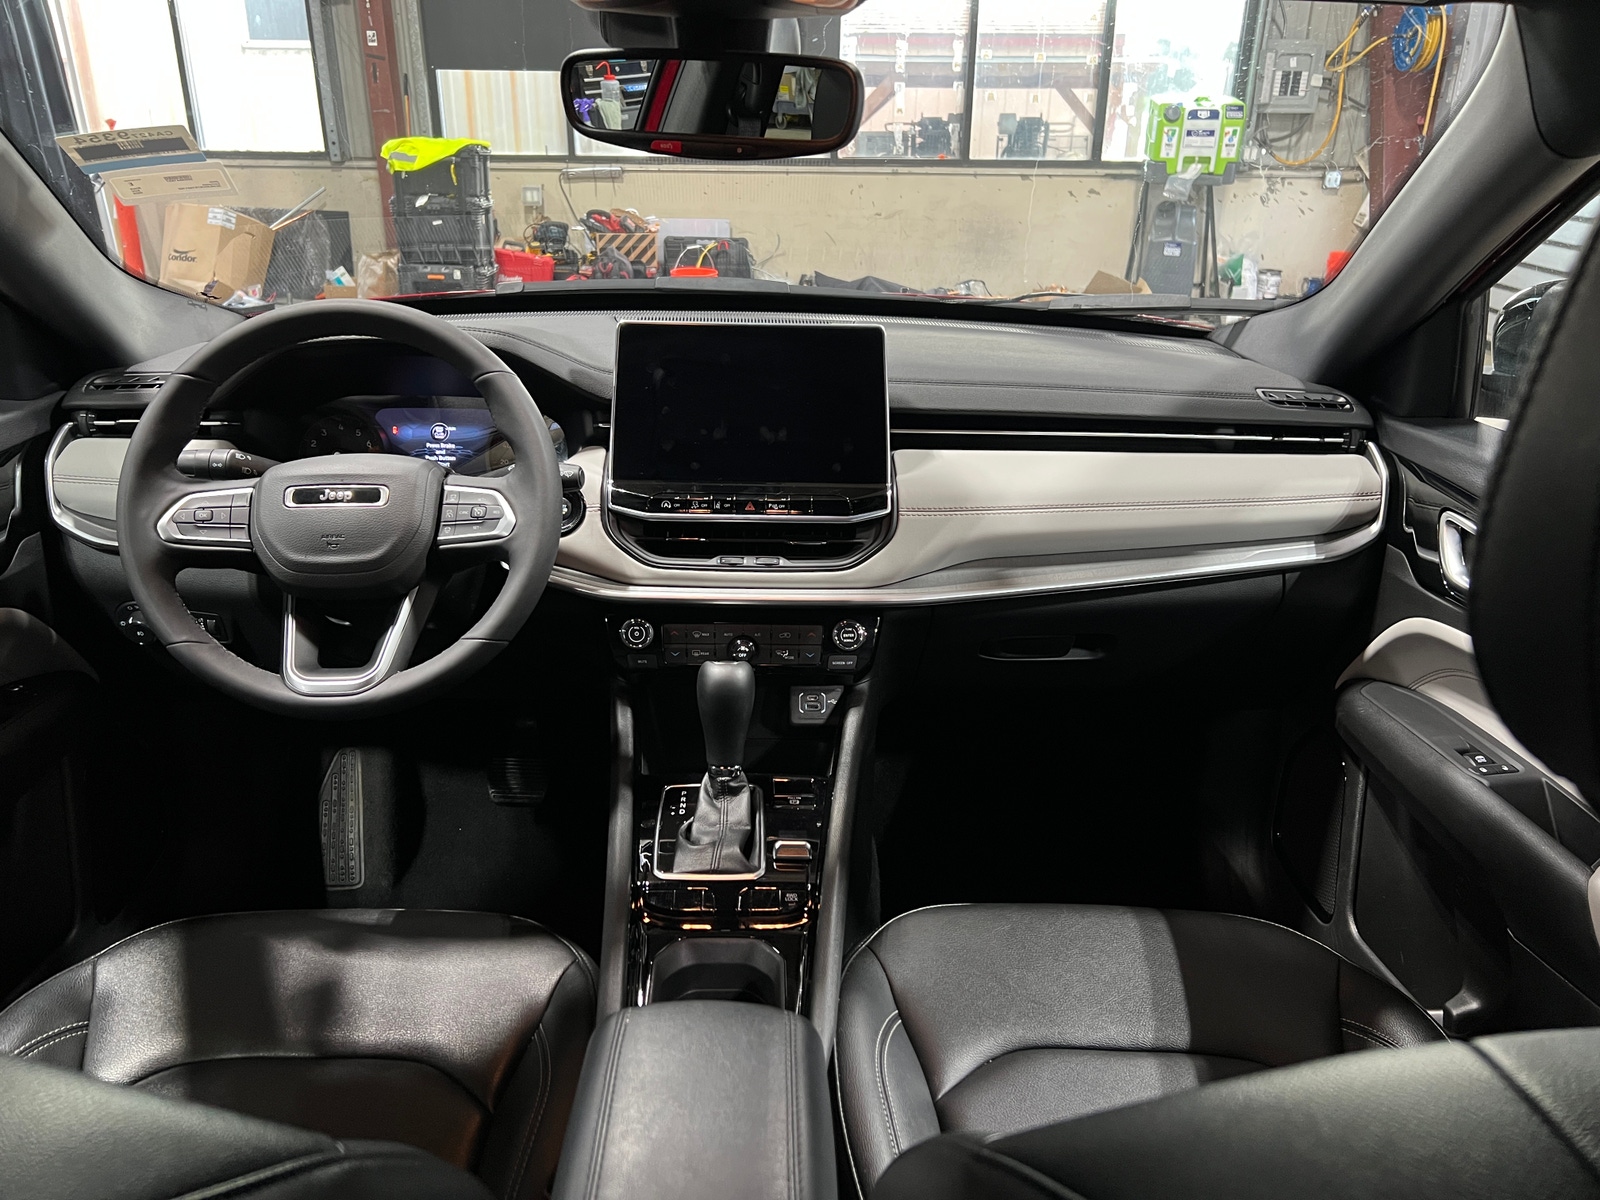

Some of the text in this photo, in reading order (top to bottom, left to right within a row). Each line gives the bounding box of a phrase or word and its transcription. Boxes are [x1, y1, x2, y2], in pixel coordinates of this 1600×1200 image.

[168, 253, 197, 263] Condor
[321, 428, 328, 437] 3
[355, 429, 361, 437] 5
[310, 439, 317, 448] 2
[319, 488, 353, 503] Jeep
